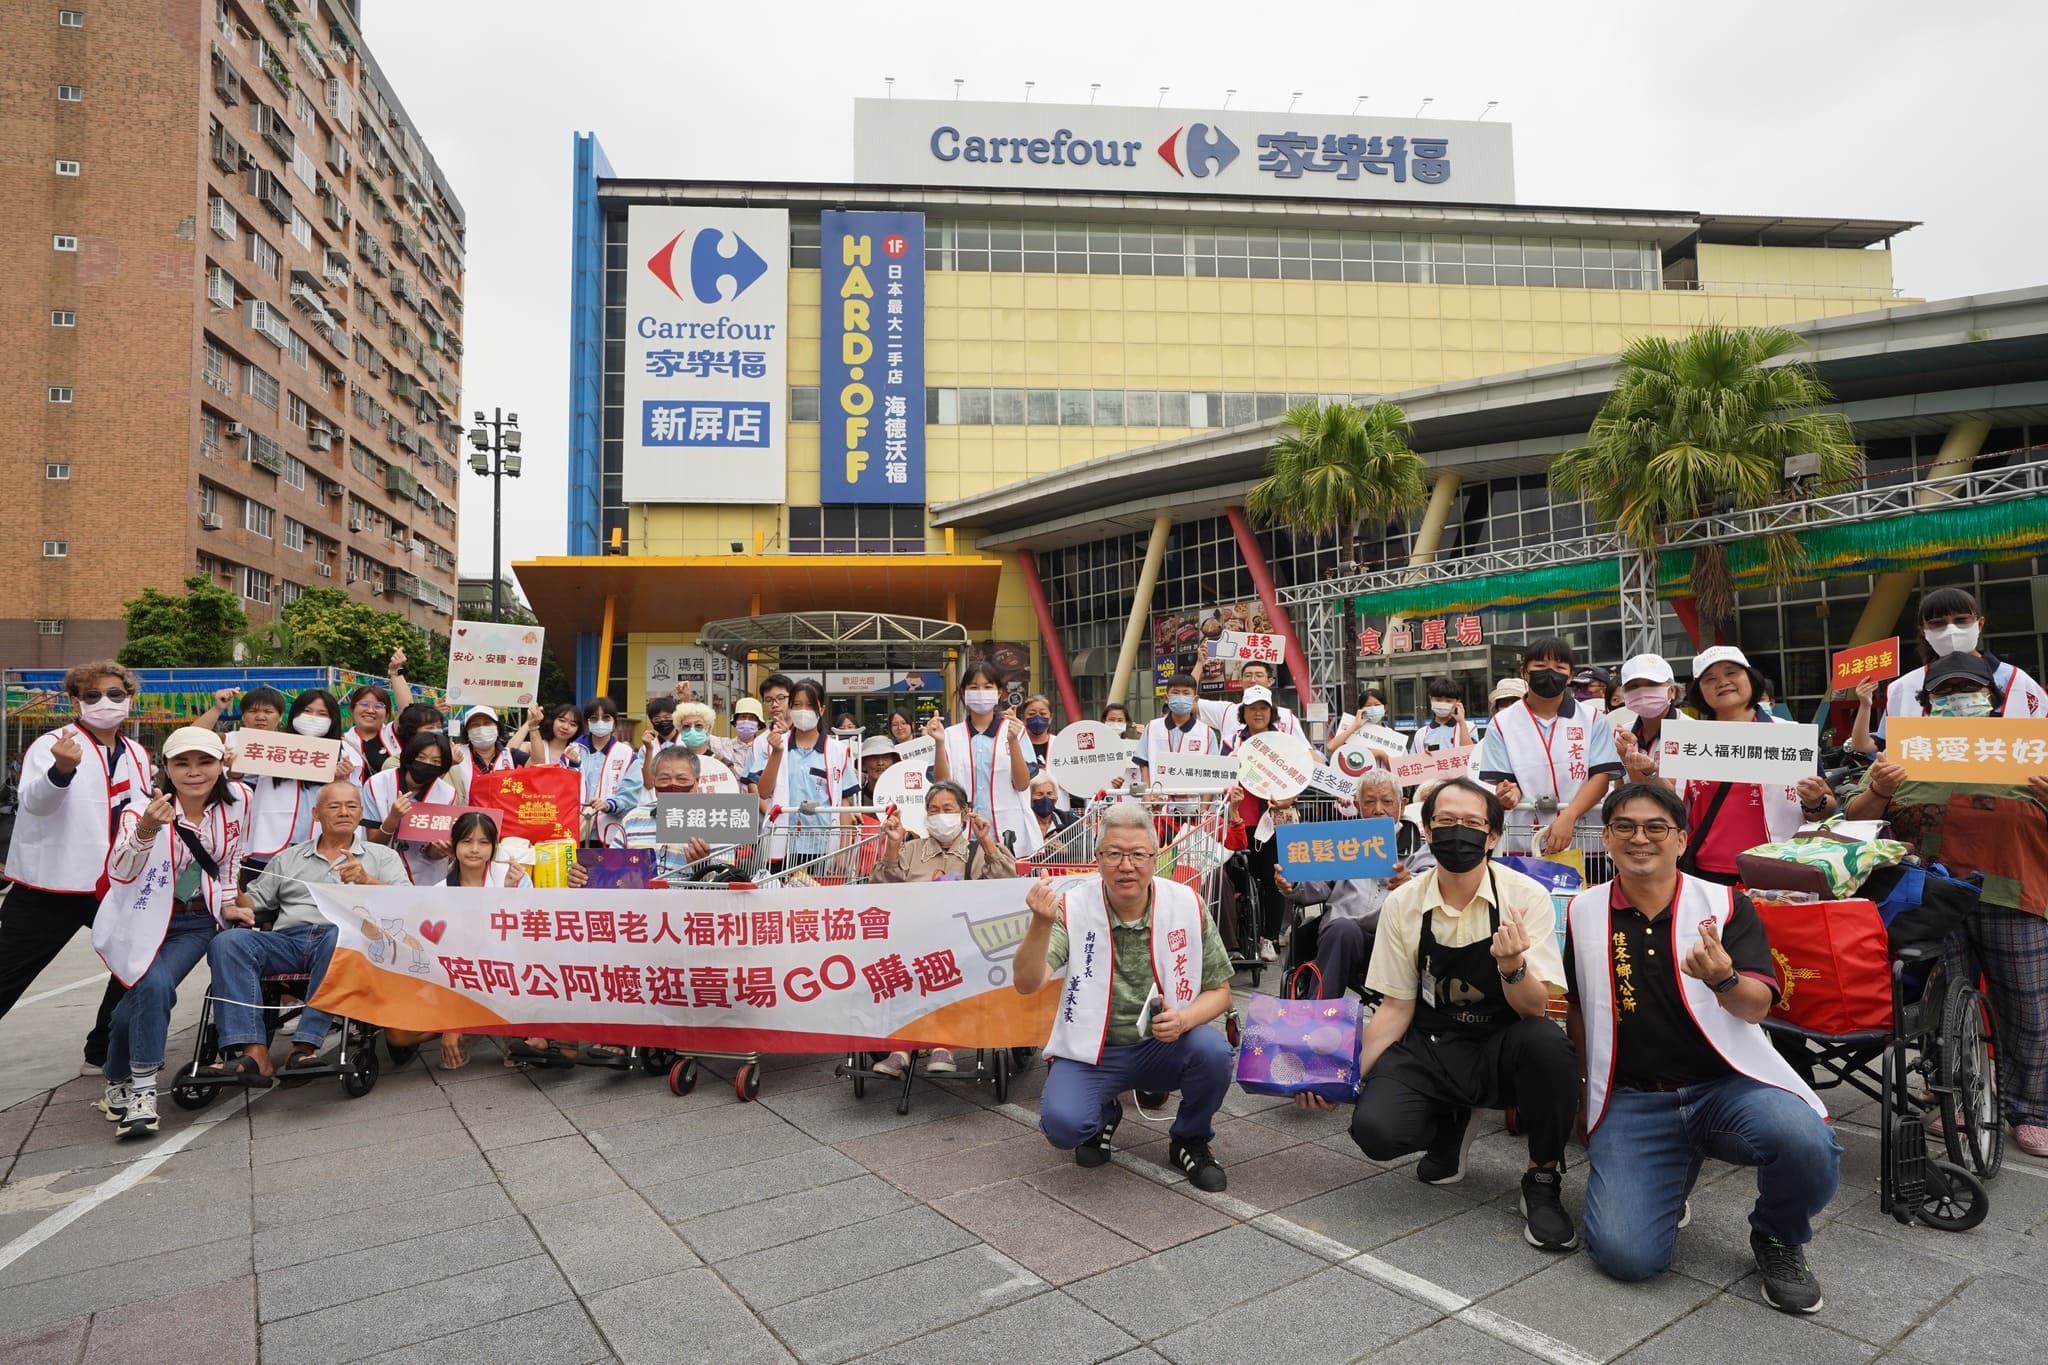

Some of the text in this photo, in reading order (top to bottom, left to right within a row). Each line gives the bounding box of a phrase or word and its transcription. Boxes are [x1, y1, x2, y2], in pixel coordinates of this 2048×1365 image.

[930, 126, 1142, 167] Carrefour
[1257, 131, 1452, 184] 家樂福
[887, 239, 904, 254] 1F
[637, 316, 776, 340] Carrefour
[887, 264, 904, 384] 日本最大二手店
[646, 349, 766, 379] 家樂福
[650, 406, 763, 443] 新屏店
[885, 395, 908, 484] 海德沃福
[1247, 635, 1273, 648] 佳冬
[1358, 615, 1483, 656] 食尚廣場
[1837, 651, 1893, 677] 幸福老化
[243, 742, 331, 769] 幸福安老
[1053, 752, 1124, 767] 老人福利關懷協會
[1568, 743, 1587, 780] 老協
[1682, 742, 1814, 762] 老人福利關懷協會
[1900, 735, 2048, 765] 傳愛共好
[1168, 766, 1238, 780] 老人福利關懷協會
[409, 814, 457, 831] 活躍
[665, 808, 751, 829] 青銀共融
[1286, 835, 1388, 864] 銀髮世代
[490, 906, 891, 946] 中華民國老人福利關懷協會
[1173, 953, 1194, 1003] 老協
[1612, 931, 1637, 1014] 佳冬鄉公所
